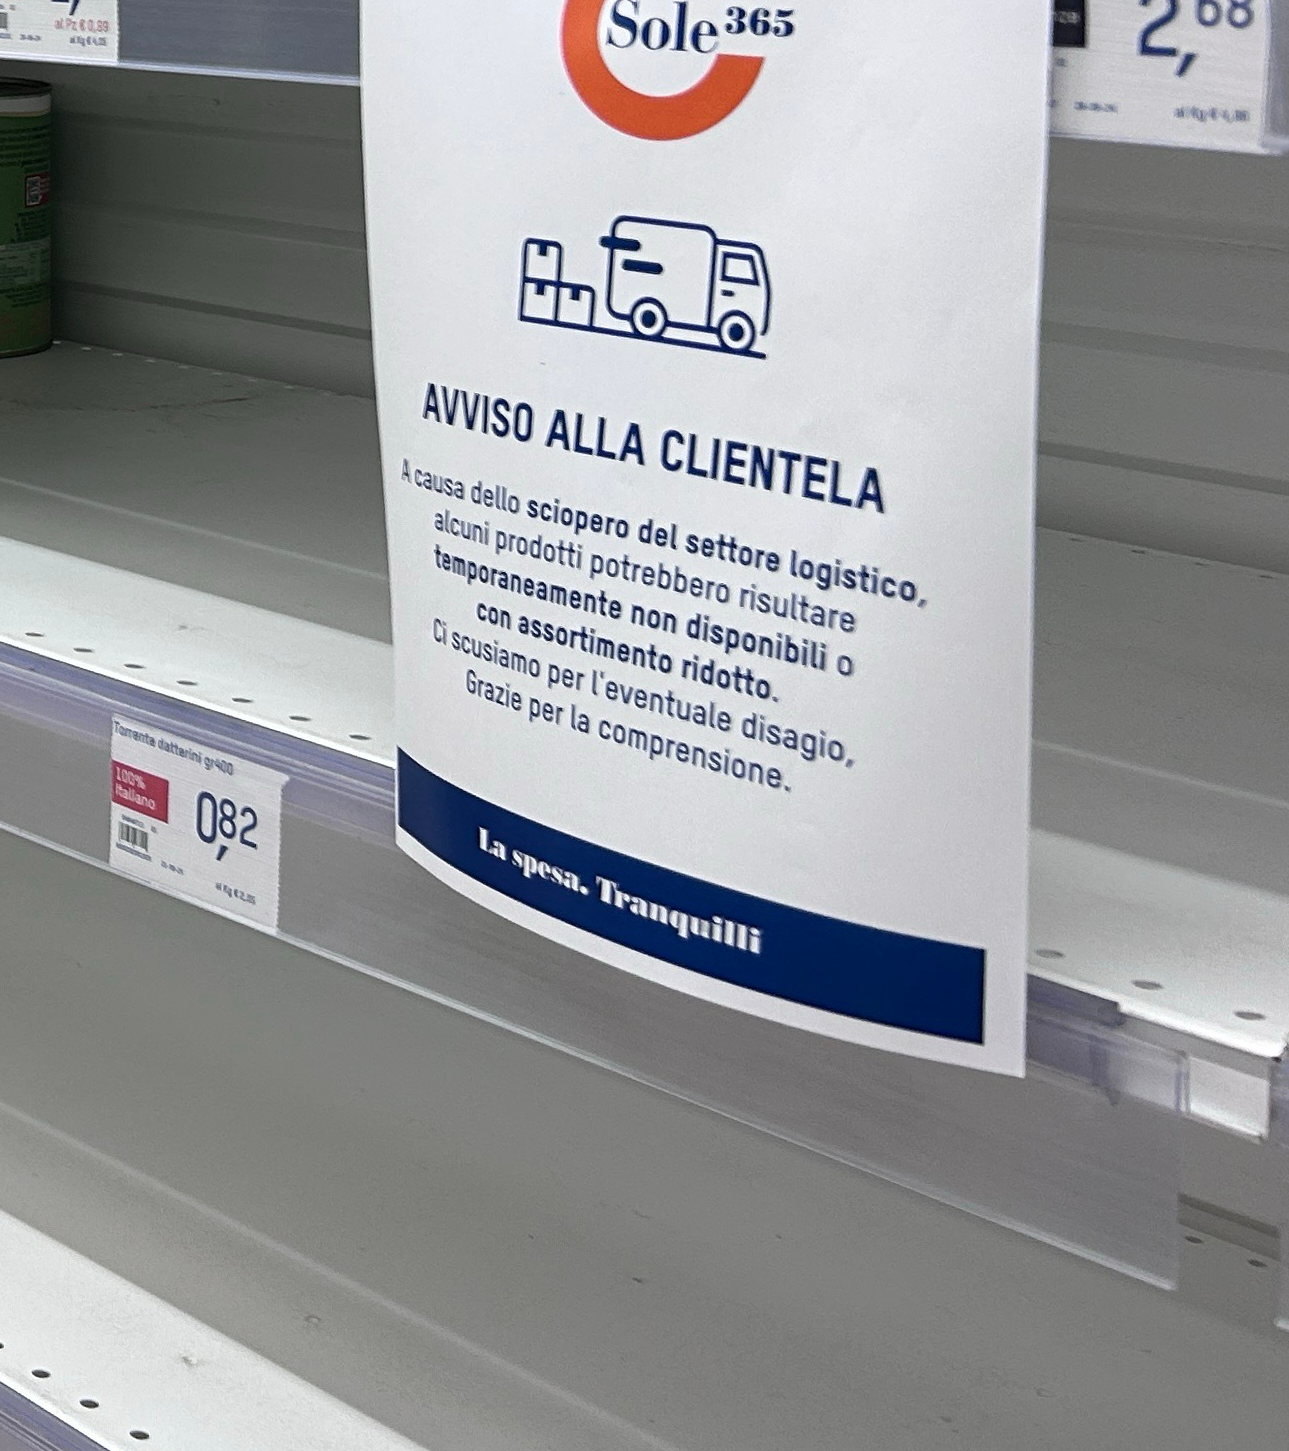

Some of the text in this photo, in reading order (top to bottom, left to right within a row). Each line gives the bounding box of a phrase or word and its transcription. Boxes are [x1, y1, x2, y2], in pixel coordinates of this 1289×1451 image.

[422, 383, 886, 514] AVVISO ALLA CLIENTELA
[401, 458, 927, 609] A causa dello sciopero del settore logistico,
[434, 509, 857, 633] alcuni prodotti potrebbero risultare
[433, 543, 854, 677] temporaneamente non disponibili o
[476, 602, 779, 703] con assortimento ridotto.
[433, 617, 856, 769] Ci scusiamo per l'eventuale disagio,
[465, 669, 792, 792] Grazie per la comprensione.
[115, 782, 156, 810] Italiano
[116, 767, 146, 790] 100%
[158, 737, 201, 764] datterini
[204, 756, 234, 776] gr400
[196, 791, 258, 861] 0,82
[478, 826, 764, 956] La spesa. Tranquilli
